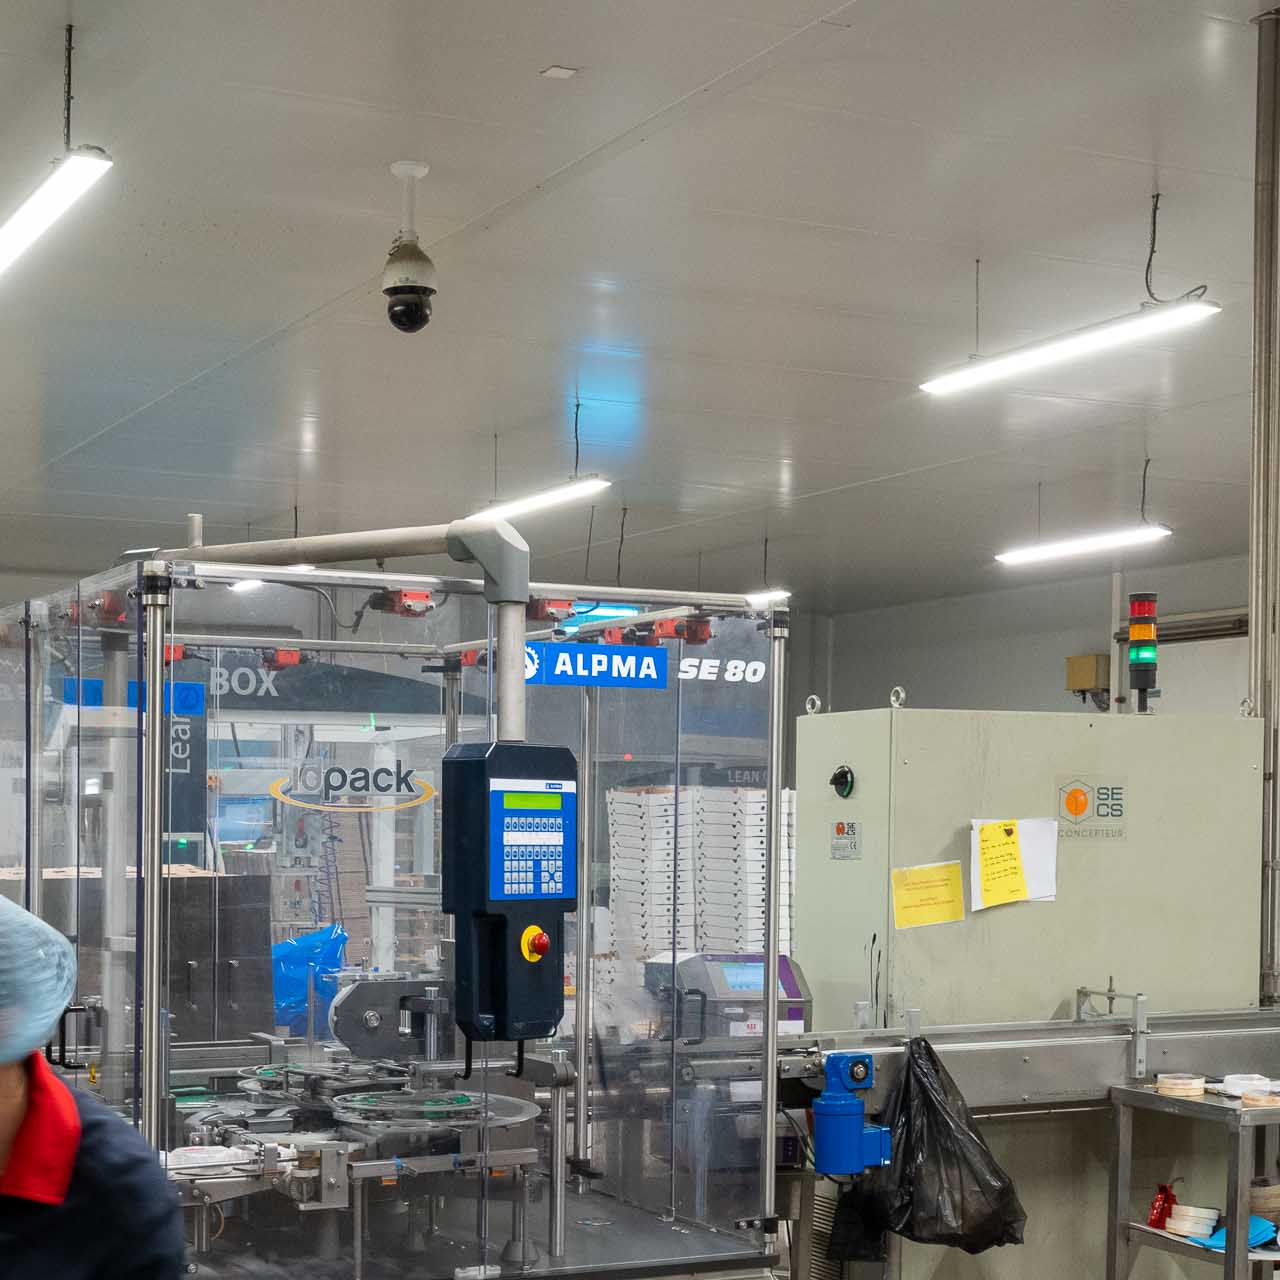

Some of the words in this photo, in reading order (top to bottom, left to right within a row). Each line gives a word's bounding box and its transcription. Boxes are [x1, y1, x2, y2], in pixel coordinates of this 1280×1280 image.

[554, 651, 658, 679] ALPMA
[677, 657, 721, 681] SE
[724, 659, 766, 683] 80
[209, 666, 279, 697] BOX
[1097, 787, 1124, 801] SE
[1096, 803, 1124, 817] CS
